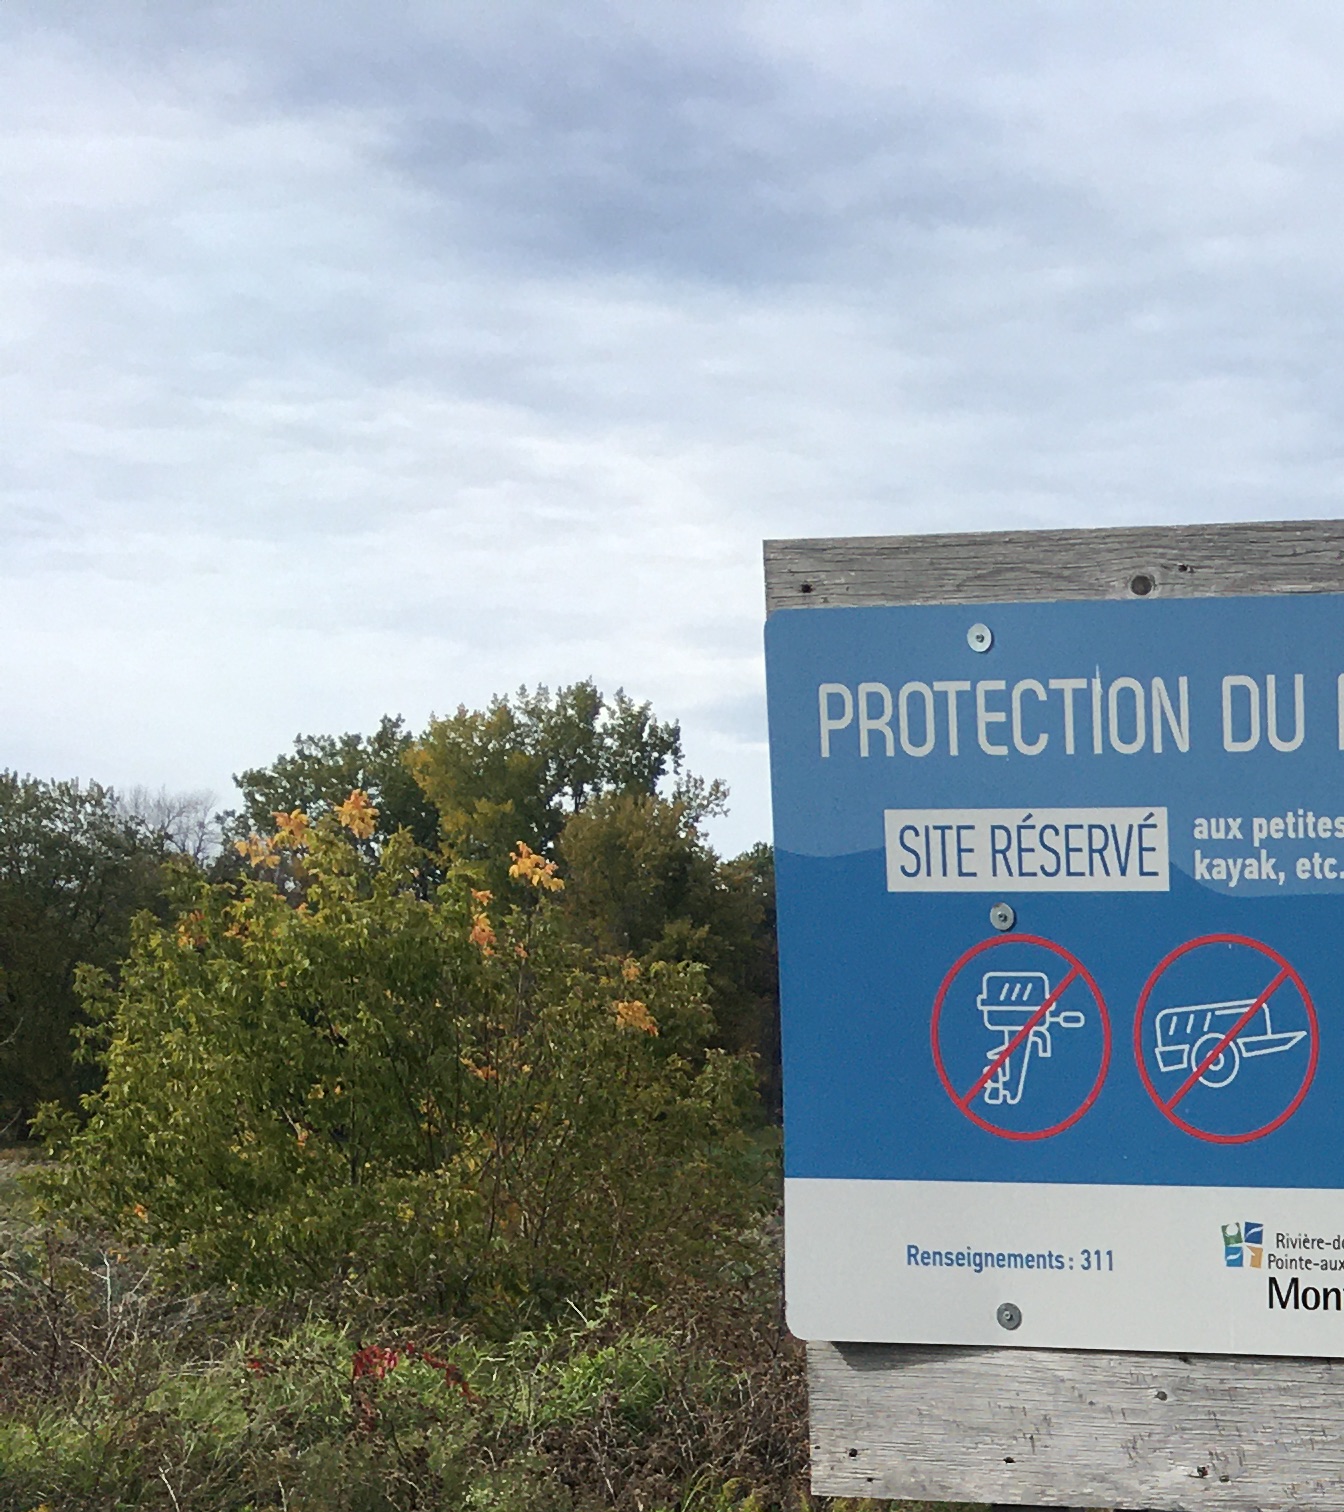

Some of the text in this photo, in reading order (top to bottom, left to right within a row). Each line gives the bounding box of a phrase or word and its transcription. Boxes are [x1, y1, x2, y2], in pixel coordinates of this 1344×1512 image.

[818, 676, 1190, 758] PROTECTION
[1222, 674, 1304, 753] DU
[900, 811, 1159, 878] SITE RÉSERVÉ
[1193, 815, 1242, 839] aux
[1194, 850, 1286, 888] kayak,
[1080, 1249, 1114, 1272] 311
